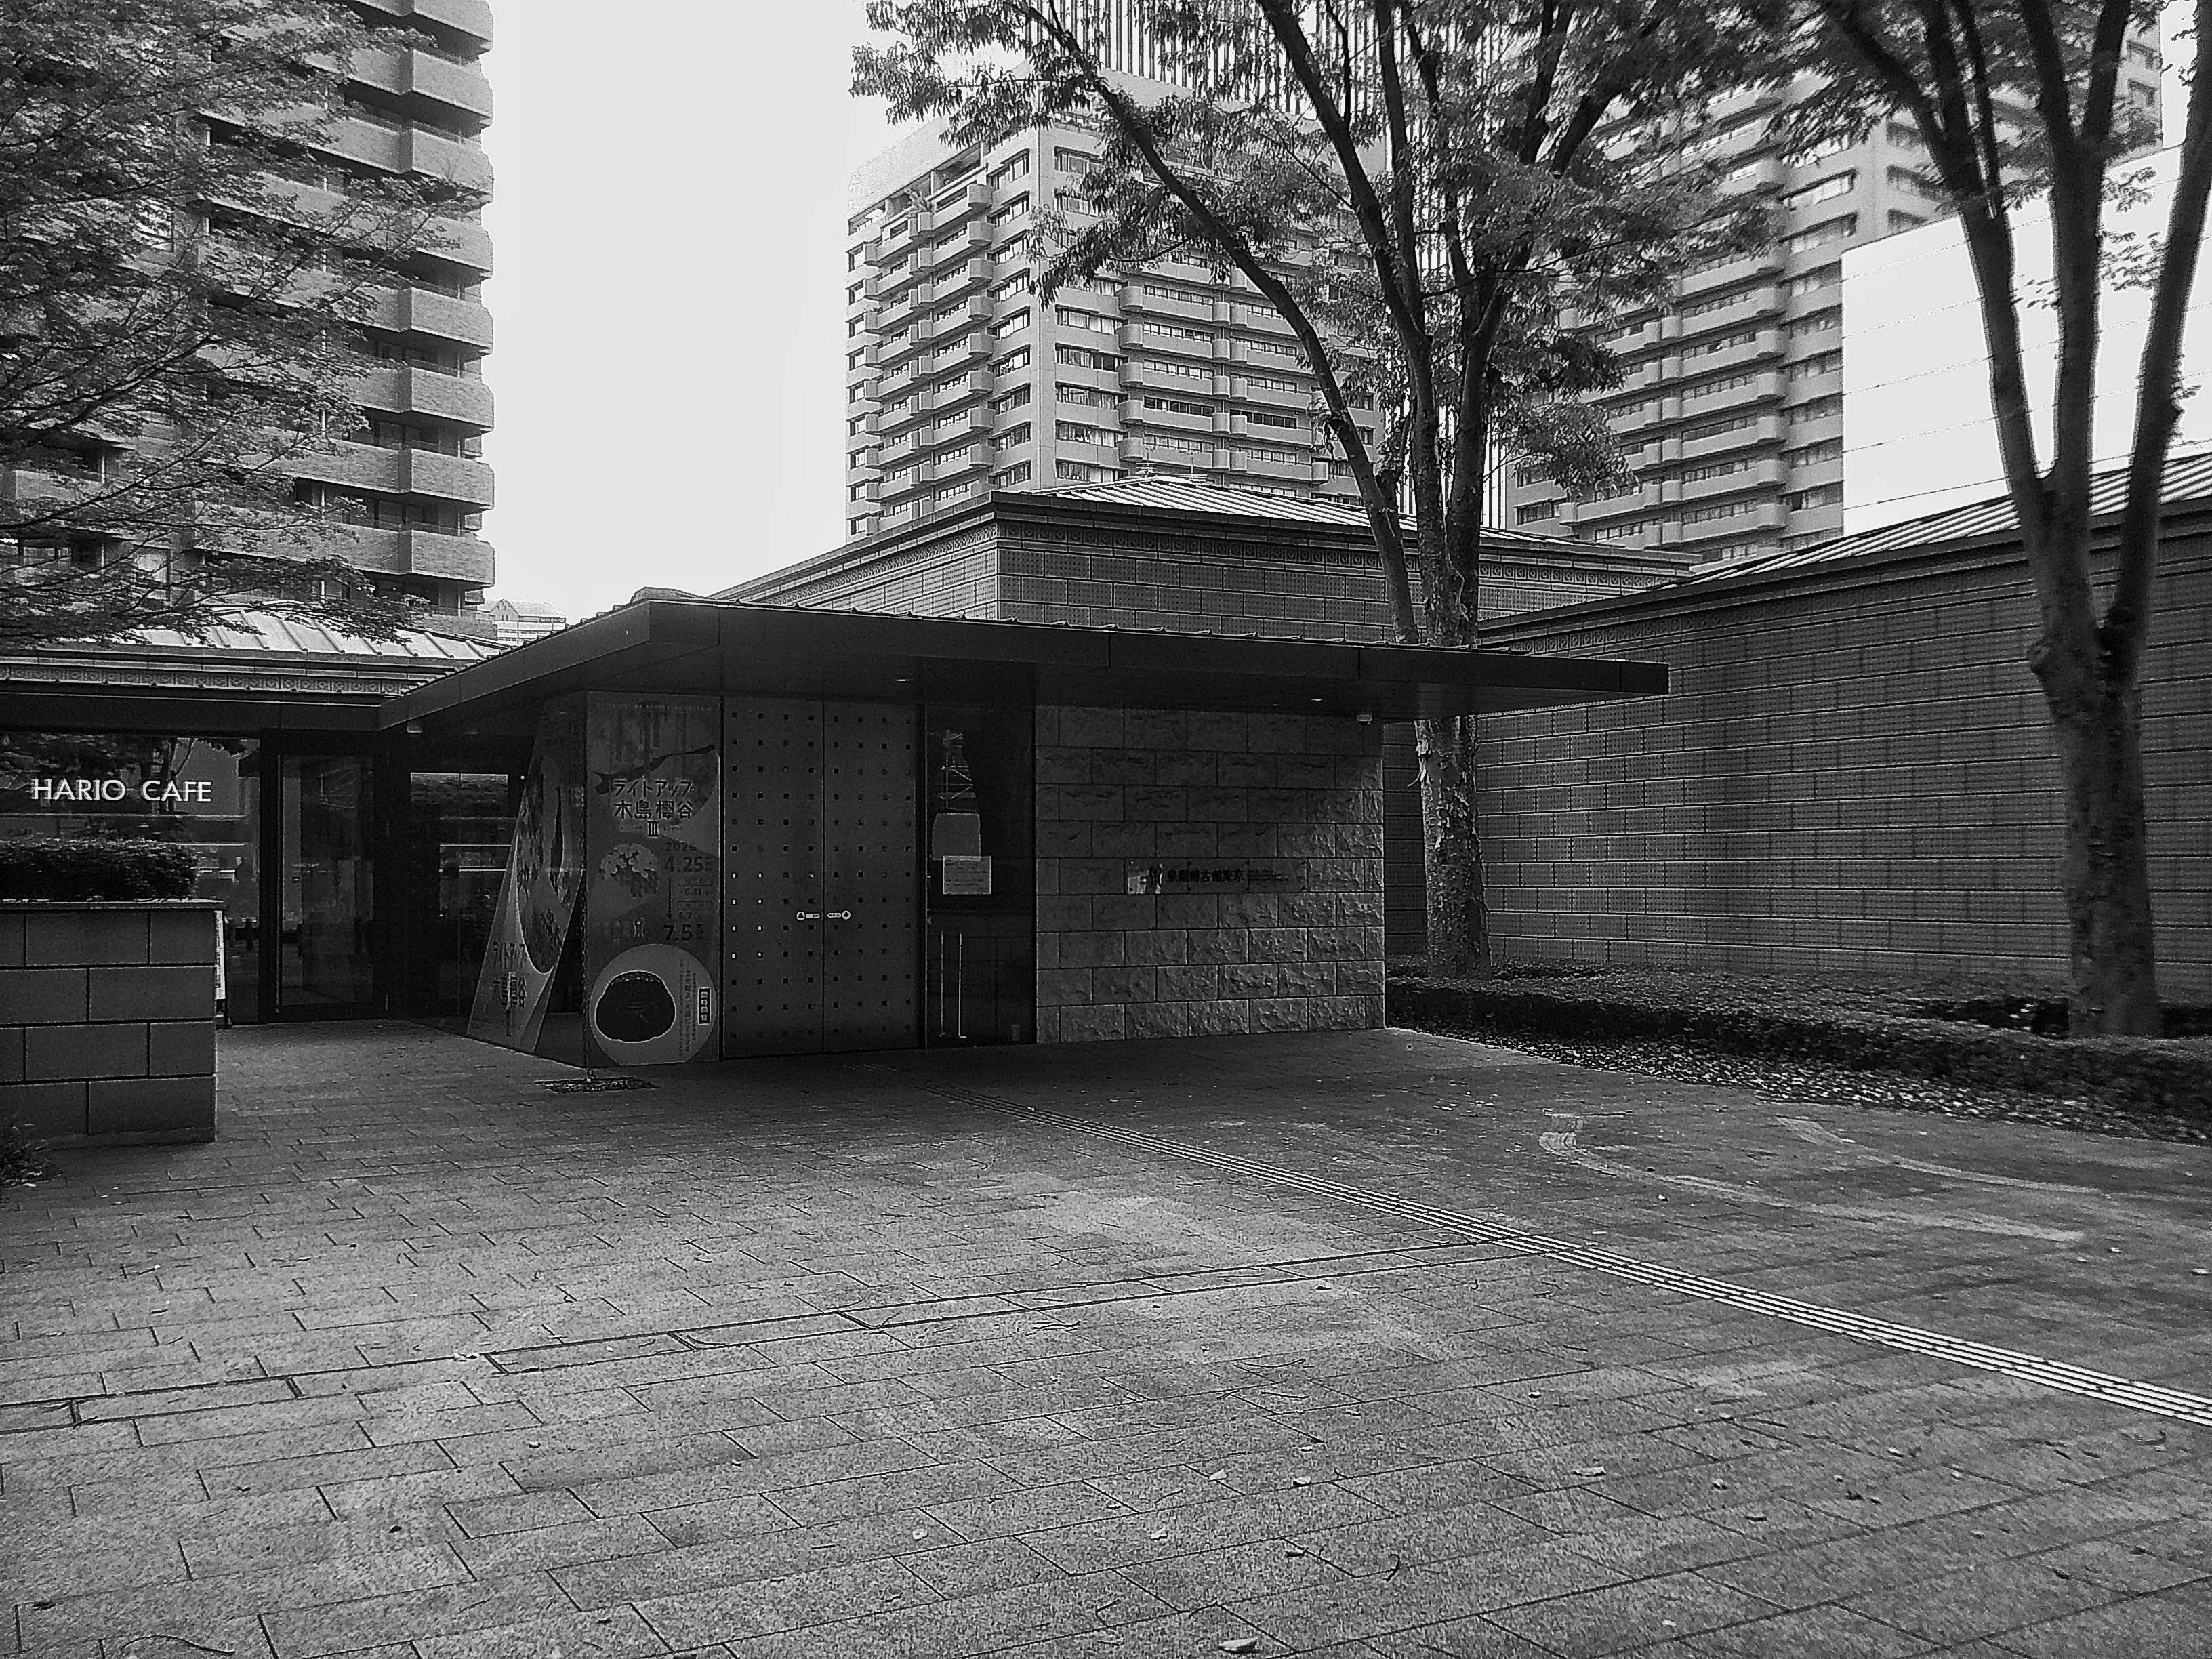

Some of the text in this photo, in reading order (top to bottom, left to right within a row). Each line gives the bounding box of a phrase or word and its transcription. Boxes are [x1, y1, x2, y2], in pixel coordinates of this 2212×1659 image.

[30, 778, 212, 802] HARIO CAFE
[613, 779, 695, 798] ライトアップ
[613, 799, 694, 819] 木島櫻谷
[665, 842, 697, 852] 2026
[664, 855, 704, 873] 4.25
[663, 924, 693, 941] 7.5
